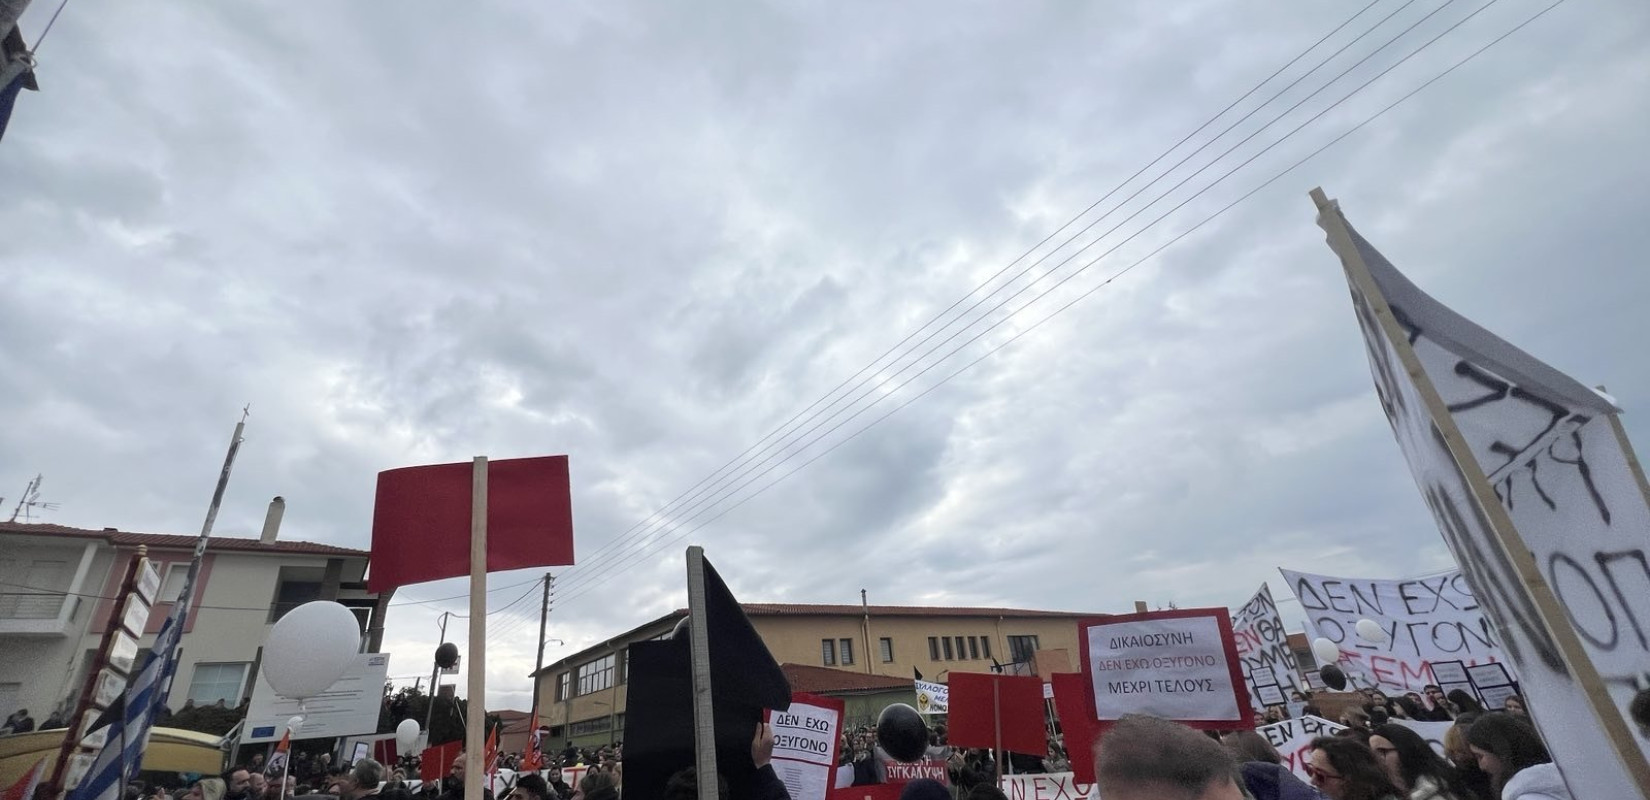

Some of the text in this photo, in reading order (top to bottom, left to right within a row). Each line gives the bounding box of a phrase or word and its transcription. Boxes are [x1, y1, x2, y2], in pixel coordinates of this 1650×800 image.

[1298, 576, 1384, 616] ΔΕΝ
[1110, 632, 1194, 650] ΔΙΚΑΙΟΣΥΝΗ
[1099, 655, 1216, 671] ΔΕΝ ΕΧΩ ΟΞΥΓΟΝΟ
[1108, 679, 1215, 694] ΜΕΧΡΙ ΤΕΛΟΥΣ
[776, 714, 829, 732] ΔΕΝ ΕΧΩ
[1263, 721, 1294, 747] ΕΝ
[773, 734, 828, 753] ΟΞΥΓΟΝΟ
[886, 765, 945, 780] ΣΥΓΚΑΛΥΨΗ
